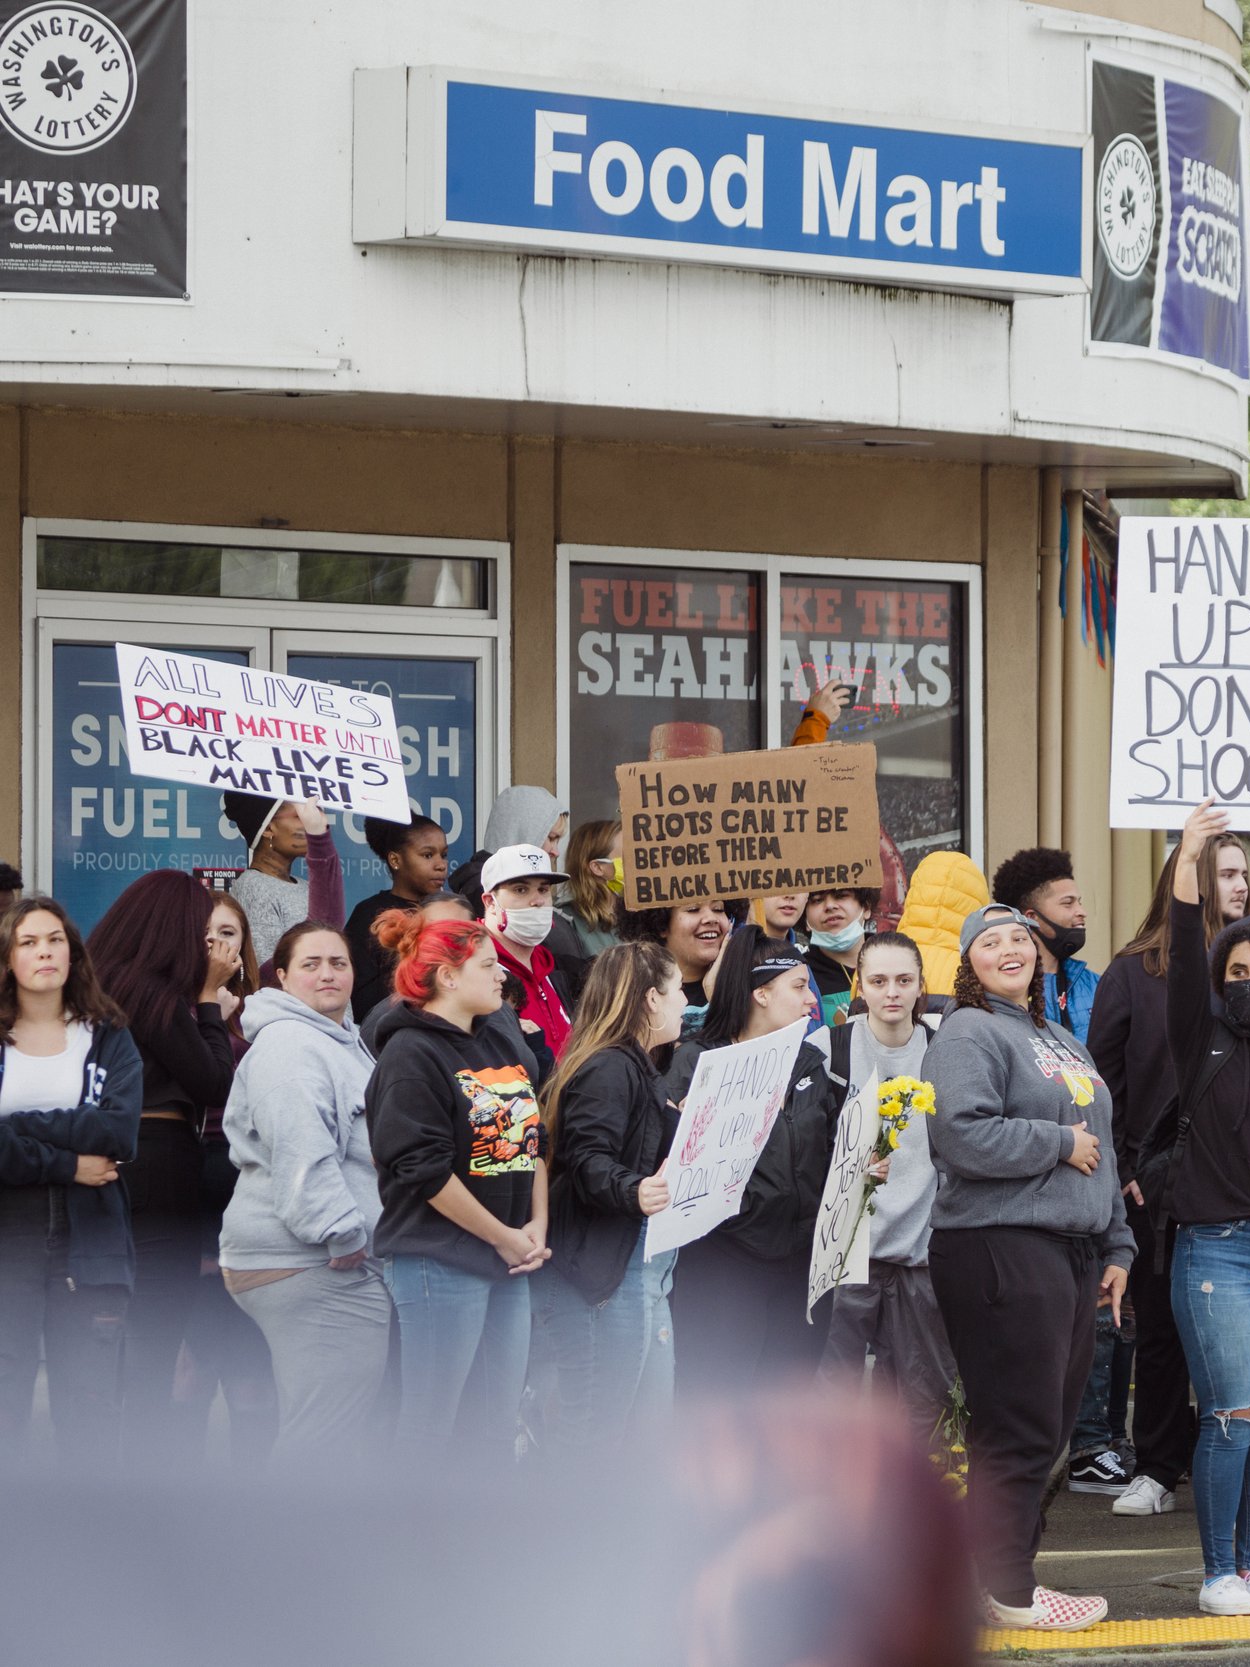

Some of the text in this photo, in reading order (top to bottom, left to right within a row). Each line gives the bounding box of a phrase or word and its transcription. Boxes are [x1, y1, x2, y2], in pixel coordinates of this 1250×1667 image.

[2, 16, 121, 112] WASHINGTON'S
[34, 91, 119, 139] LOTTERY
[0, 179, 160, 210] HAT'S YOUR
[534, 109, 1007, 257] Food Mart
[1103, 149, 1150, 236] WASHINGTON'S
[14, 208, 118, 235] GAME?
[1115, 221, 1149, 265] LOTTERY
[1179, 209, 1241, 300] SCRATCH
[580, 578, 704, 629] FUEL
[855, 590, 949, 639] THE
[134, 656, 382, 728] ALL LIVES
[578, 630, 951, 707] SEAHAWKS
[134, 695, 226, 732] DONT
[235, 712, 327, 746] MATTER
[335, 729, 403, 761] UNTIL
[140, 727, 245, 762] BLACK
[272, 747, 389, 786] LIVES
[209, 764, 354, 809] MATTER!
[731, 778, 807, 804] MANY
[71, 787, 201, 839] FUEL
[632, 807, 849, 842] RIOTS CAN IT BE
[73, 852, 162, 872] PROUDLY
[168, 853, 247, 871] SERVING
[202, 870, 236, 878] WE HONOR
[635, 836, 782, 870] BEFORE THEM
[636, 874, 711, 903] BLACK
[714, 1045, 791, 1107] HANDS
[834, 1100, 863, 1164] NO
[820, 1198, 850, 1251] NO
